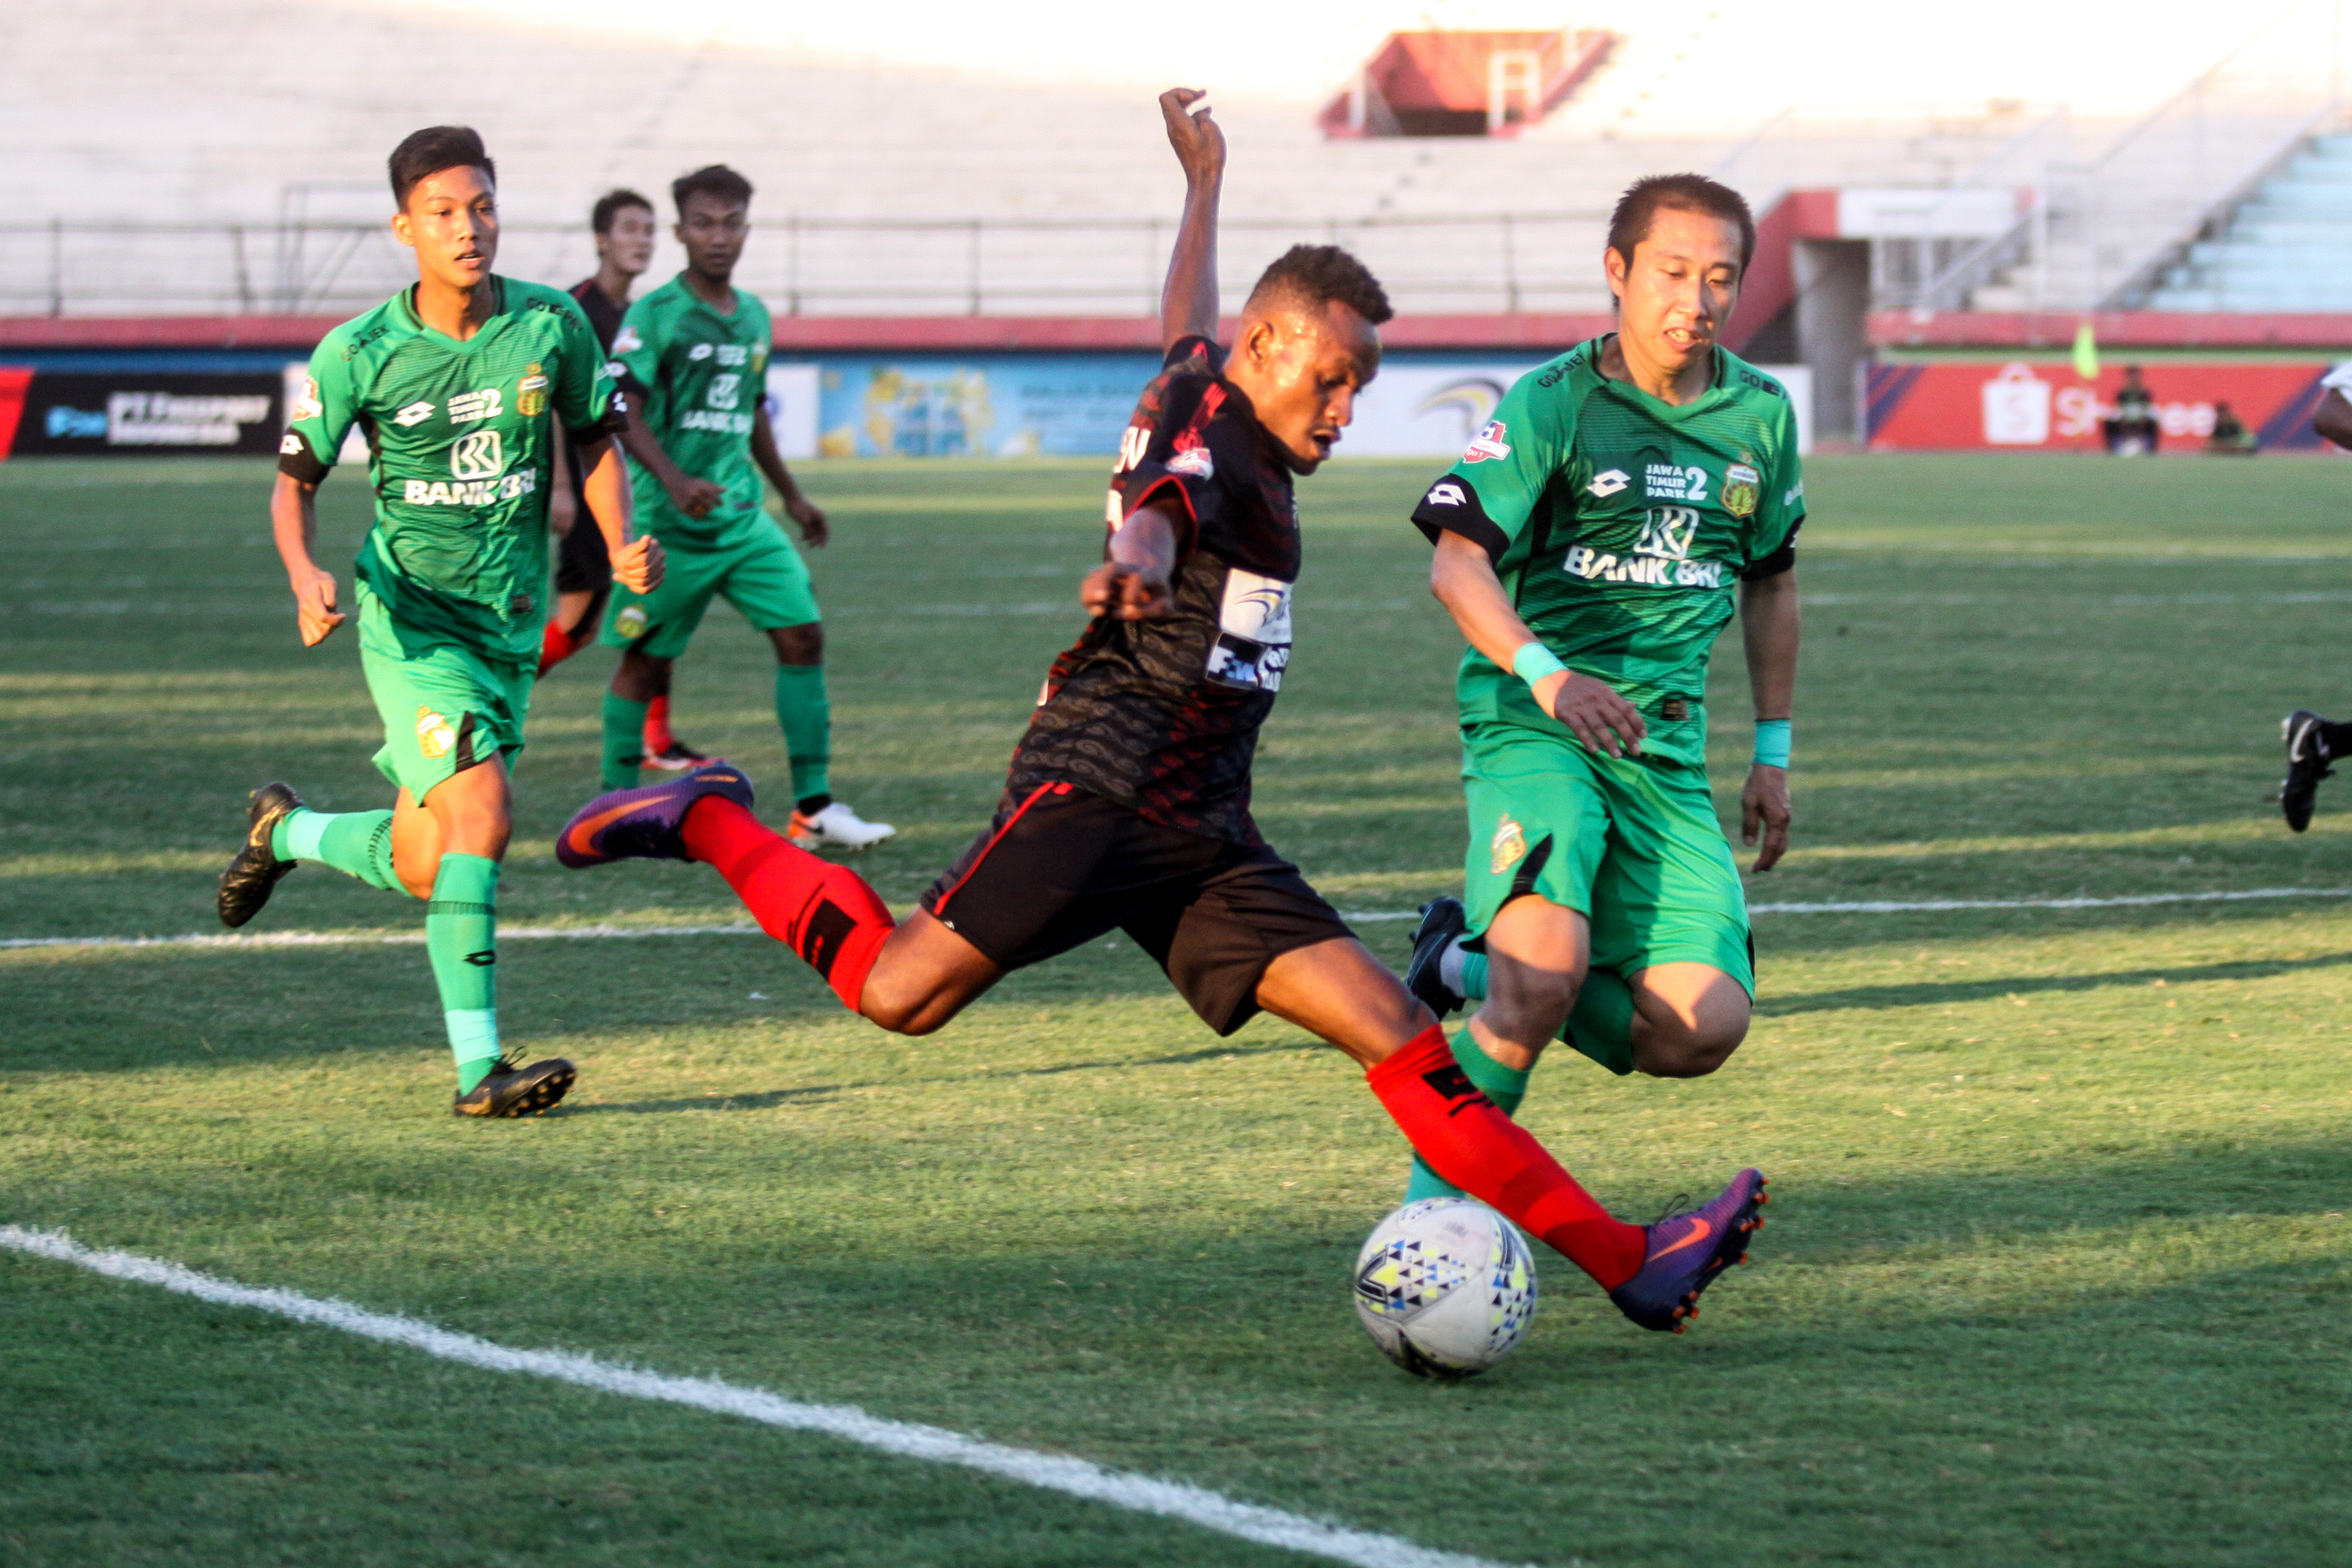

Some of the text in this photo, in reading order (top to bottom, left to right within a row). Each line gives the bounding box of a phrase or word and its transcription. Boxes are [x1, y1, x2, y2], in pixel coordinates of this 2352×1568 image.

[480, 387, 504, 418] 2
[1646, 464, 1684, 476] JAWA
[1646, 475, 1686, 489] TIMUR
[1685, 466, 1708, 500] 2
[403, 479, 497, 506] BANK
[1647, 487, 1686, 499] PARK
[1563, 544, 1673, 585] BANK
